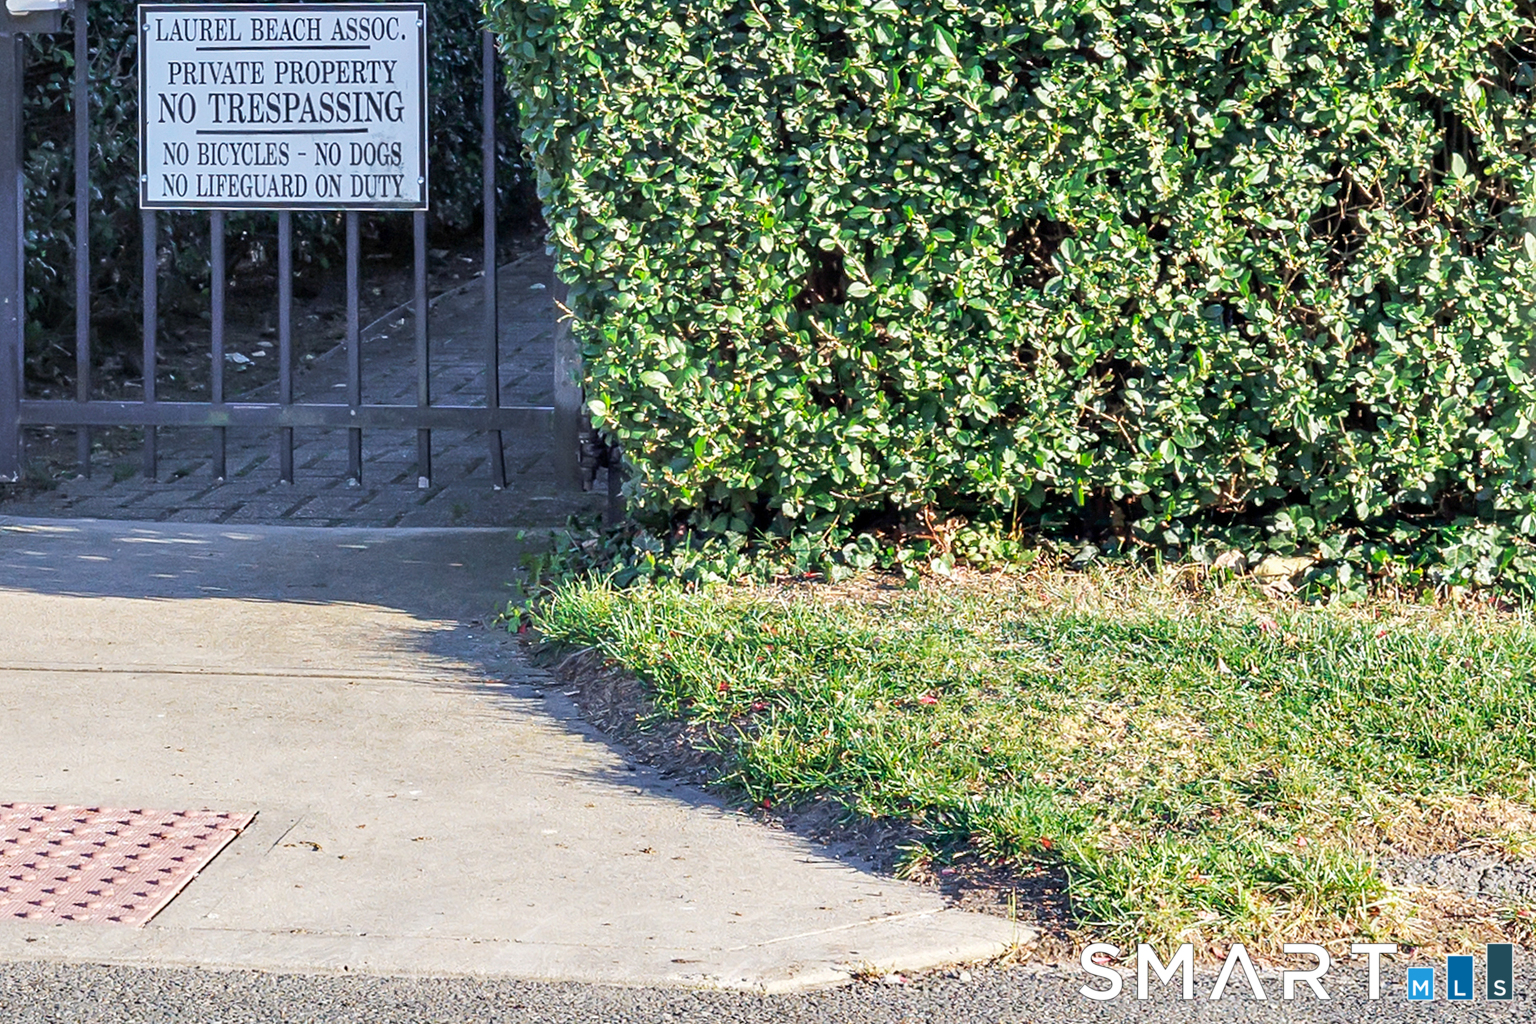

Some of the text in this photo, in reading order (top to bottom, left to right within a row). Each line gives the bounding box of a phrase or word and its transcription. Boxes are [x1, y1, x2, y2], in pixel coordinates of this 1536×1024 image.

[155, 16, 406, 42] LAUREL BEACH ASSOC.
[167, 60, 398, 85] PRIVATE PROPERTY
[157, 90, 405, 124] NO TRESPASSING
[162, 142, 189, 166] NO
[196, 142, 290, 166] BICYCLES
[314, 142, 341, 166] NO
[349, 141, 402, 166] DOGS
[161, 173, 405, 198] NO LIFEGUARD ON DUTY
